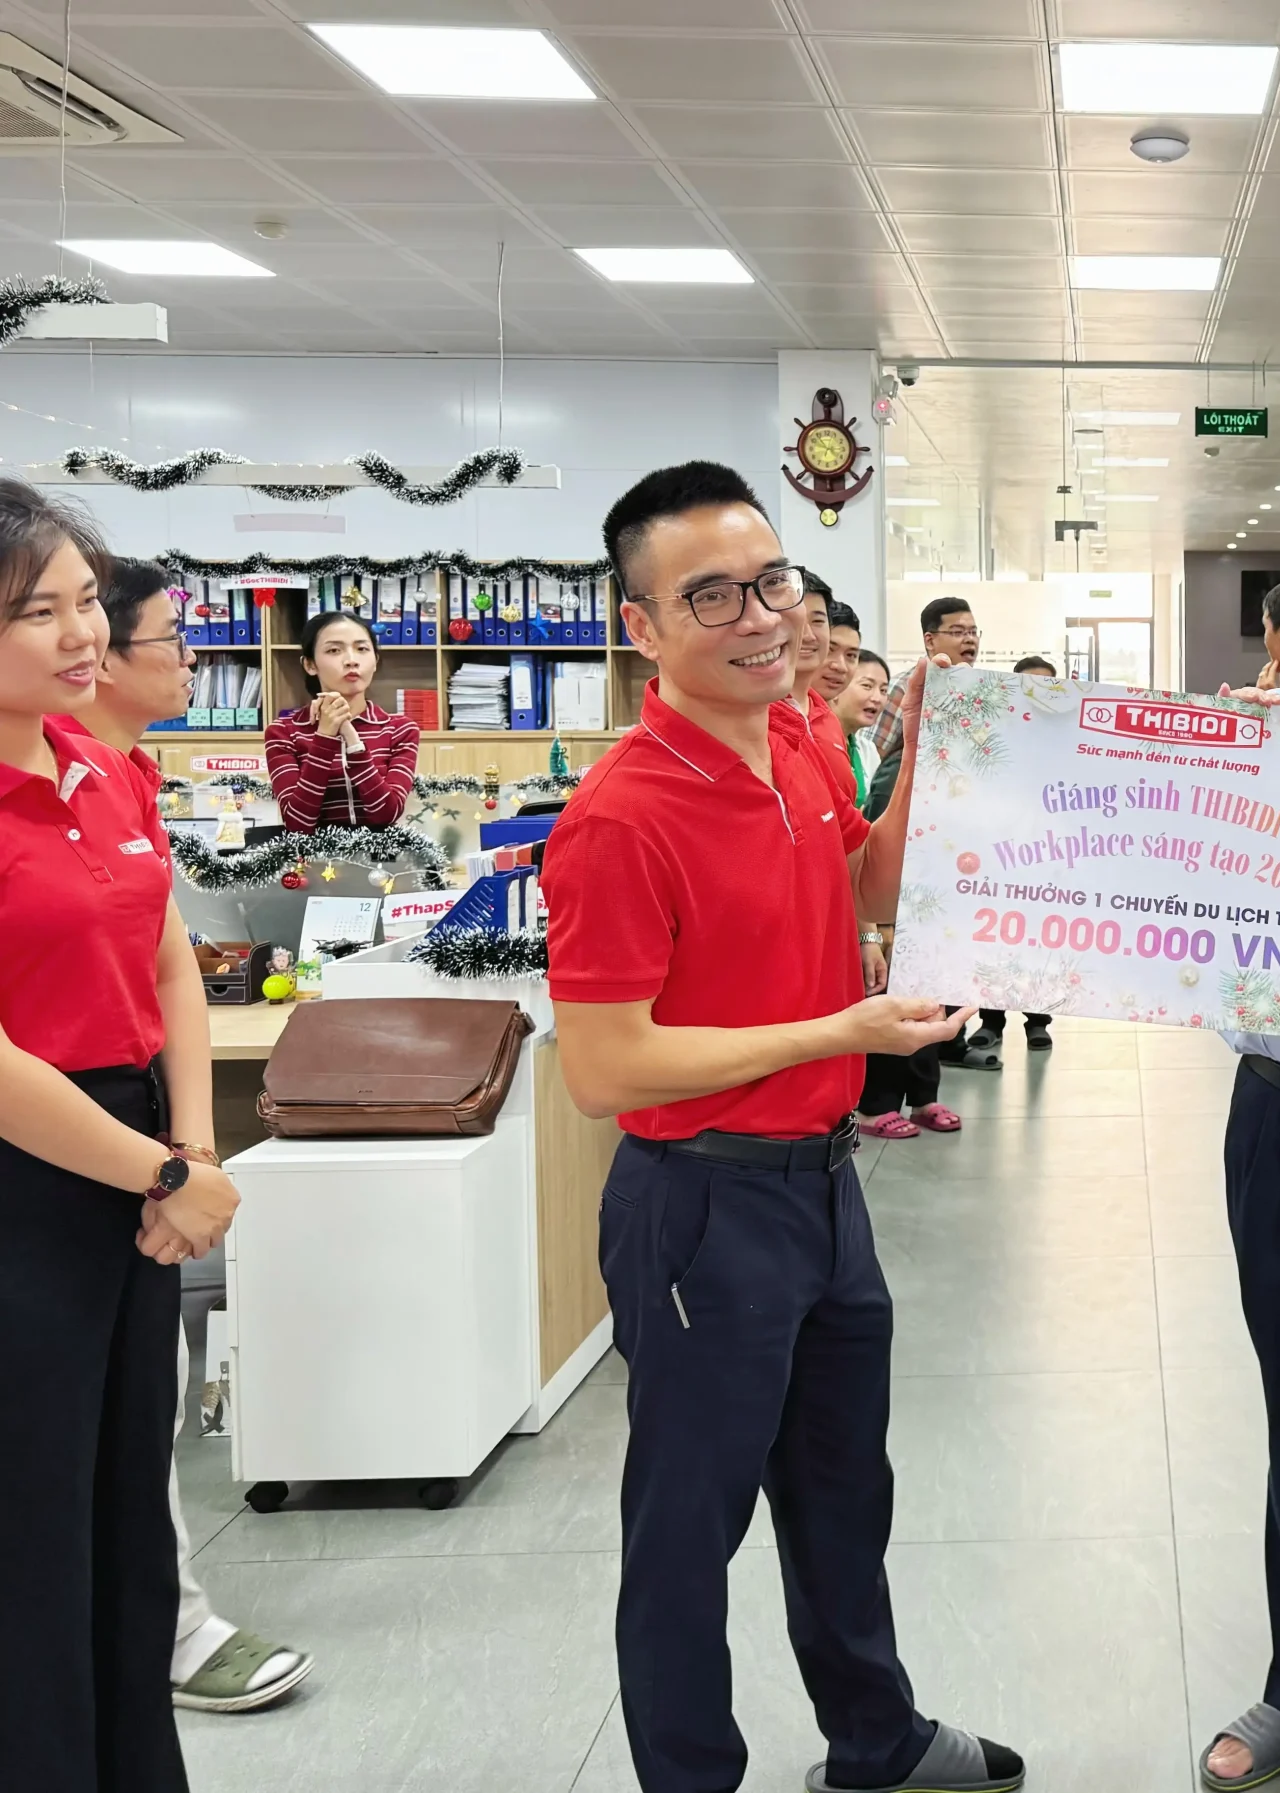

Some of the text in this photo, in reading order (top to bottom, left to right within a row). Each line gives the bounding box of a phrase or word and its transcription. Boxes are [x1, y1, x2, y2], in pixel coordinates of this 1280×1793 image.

[1222, 412, 1259, 426] THOÁT
[1126, 707, 1228, 736] THIBIDI
[208, 760, 258, 770] THIBIDI
[1076, 743, 1261, 776] Sức mạnh đến từ chất lượng
[1042, 780, 1118, 819] Giáng
[1124, 778, 1181, 812] sinh
[991, 826, 1135, 872] Workplace
[1141, 832, 1204, 874] sáng
[1209, 840, 1251, 876] tạo
[359, 903, 371, 912] 12
[955, 876, 999, 897] GIẢI
[1004, 882, 1087, 906] THƯỞNG
[1094, 893, 1102, 908] 1
[1110, 894, 1188, 916] CHUYẾN
[1193, 902, 1220, 919] DU
[1226, 906, 1270, 926] LỊCH
[972, 908, 1216, 964] 20.000.000
